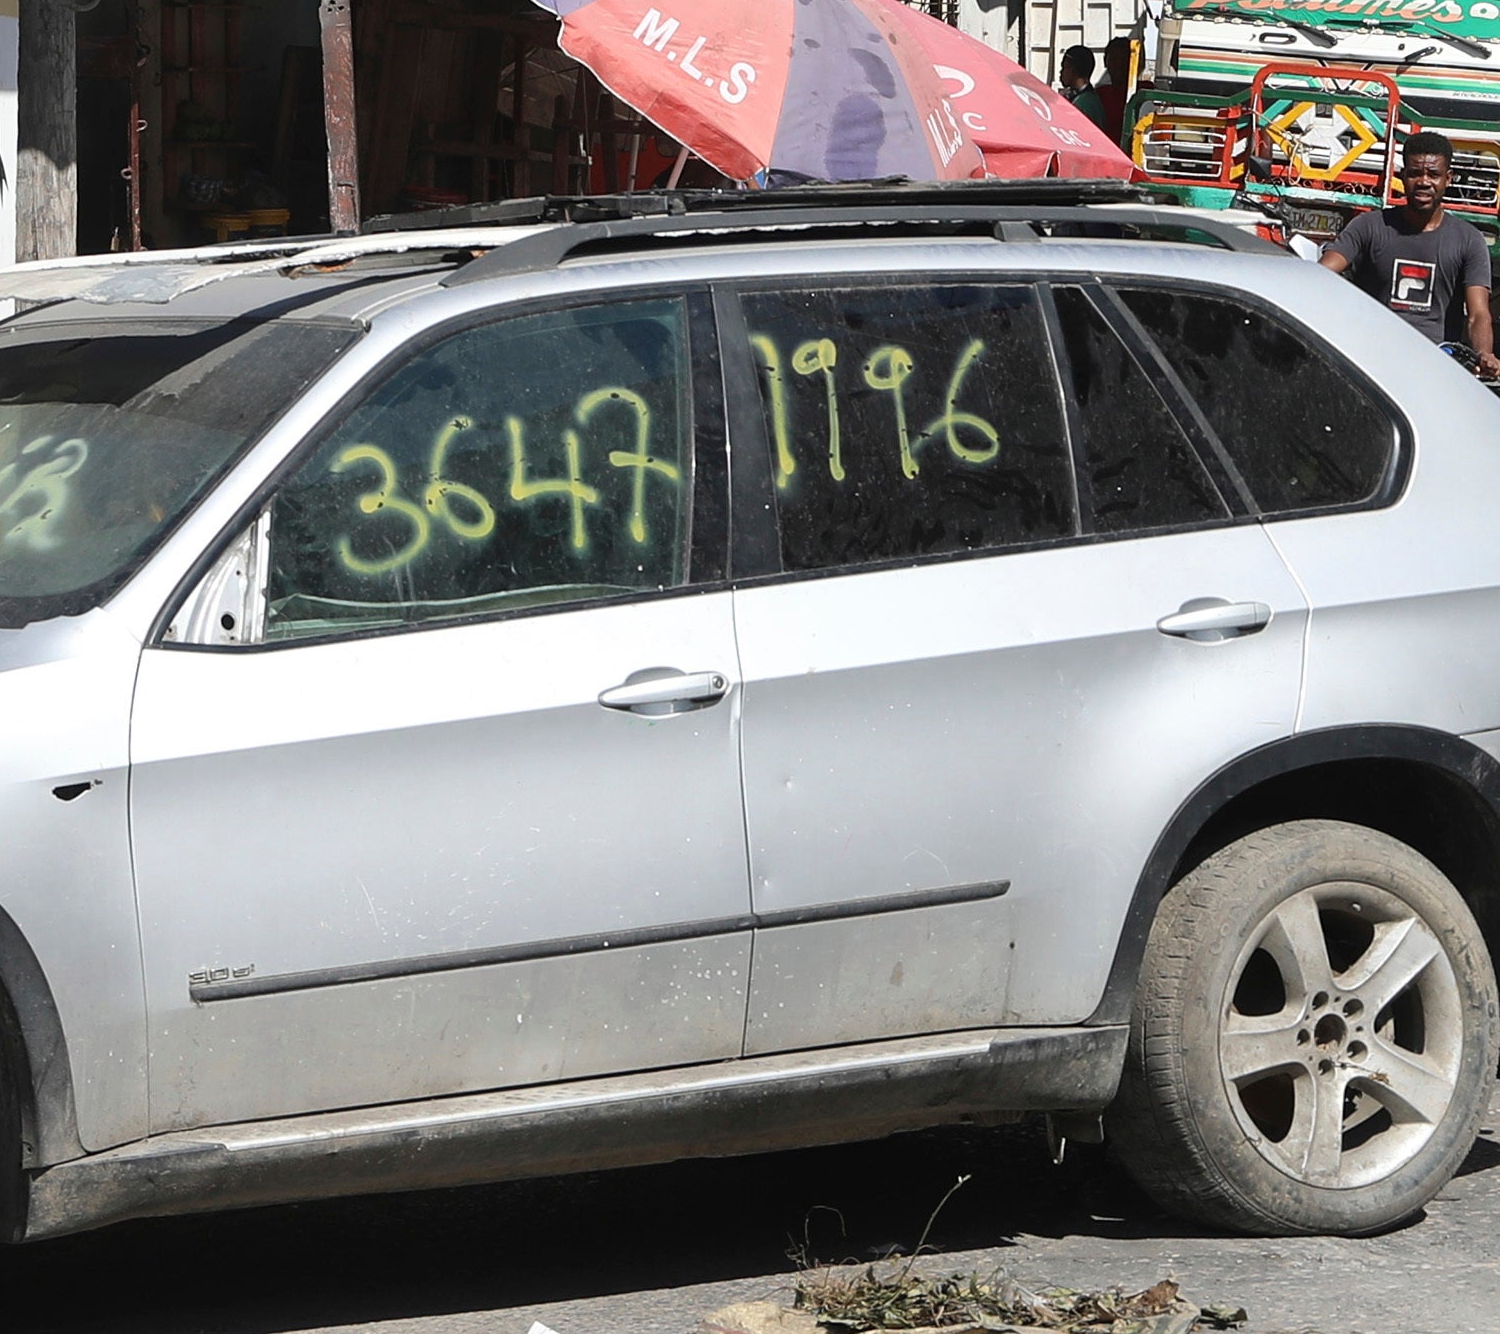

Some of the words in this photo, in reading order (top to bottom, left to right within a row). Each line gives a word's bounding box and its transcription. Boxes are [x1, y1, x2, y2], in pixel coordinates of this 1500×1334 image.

[632, 7, 757, 104] M.L.S
[332, 386, 679, 575] 3647
[749, 334, 1003, 489] 1996
